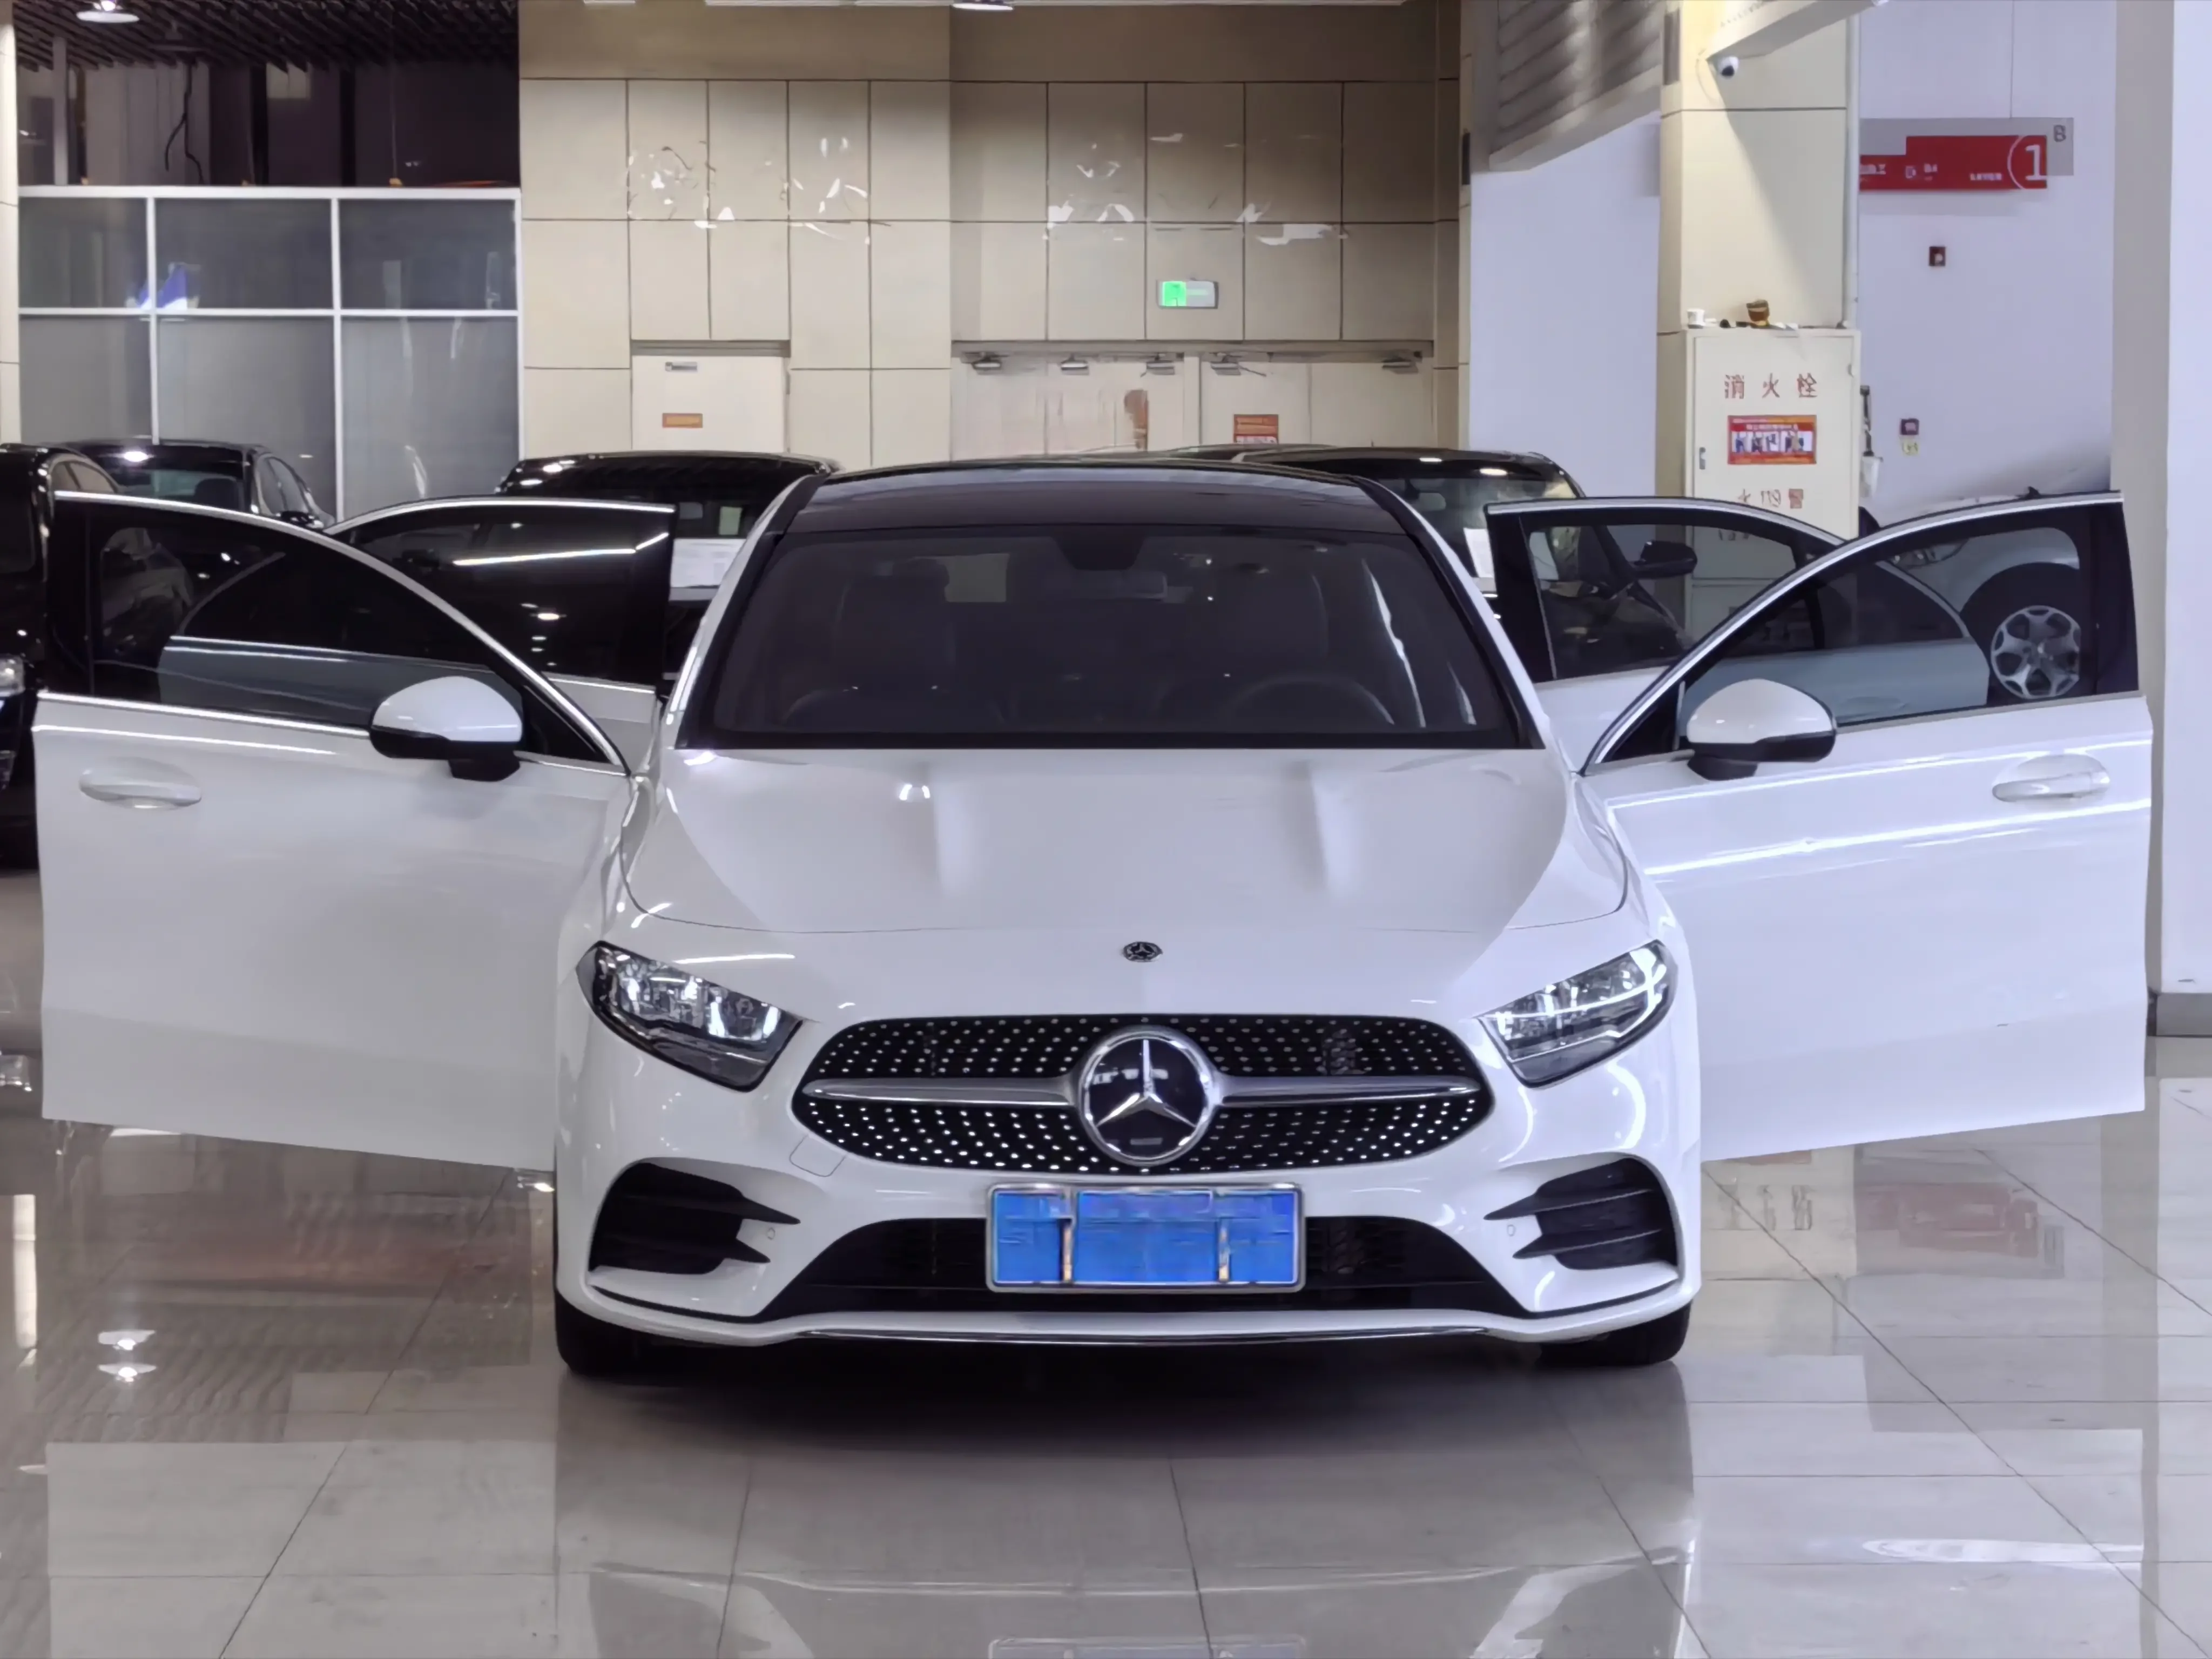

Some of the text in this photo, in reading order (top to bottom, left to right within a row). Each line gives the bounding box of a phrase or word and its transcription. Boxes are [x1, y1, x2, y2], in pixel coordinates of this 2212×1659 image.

[2025, 144, 2047, 180] 1
[1724, 373, 1817, 399] 消火栓
